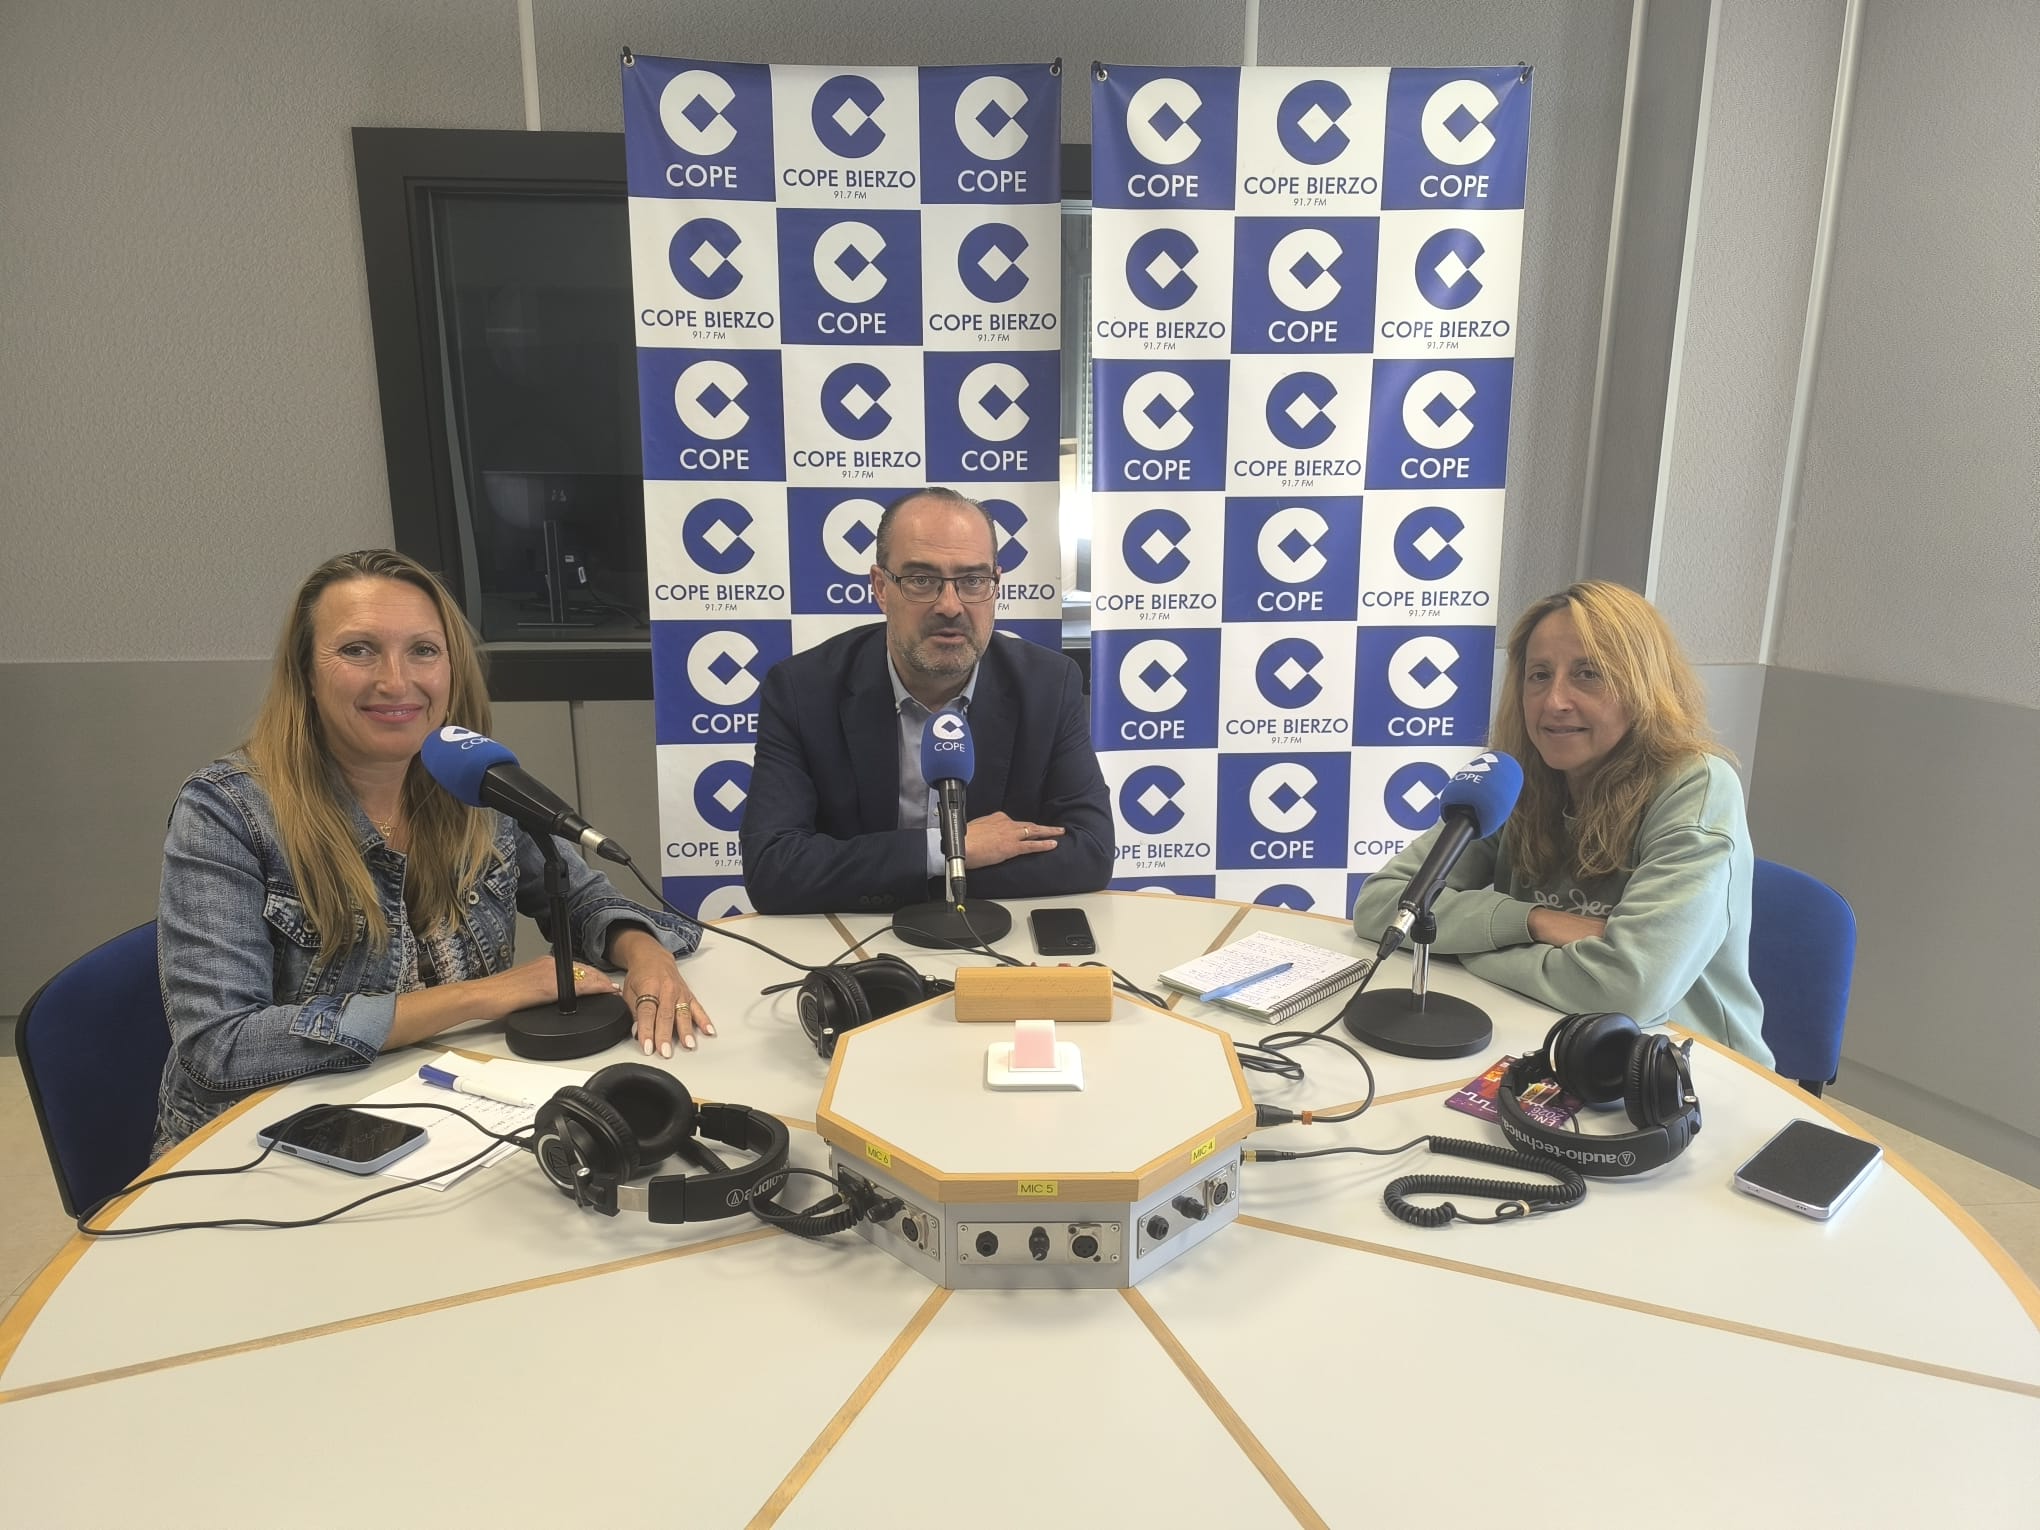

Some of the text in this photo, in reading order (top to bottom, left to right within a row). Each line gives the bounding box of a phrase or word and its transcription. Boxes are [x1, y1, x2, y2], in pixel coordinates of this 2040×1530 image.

[667, 164, 737, 188] COPE
[783, 169, 915, 188] COPE BIERZO
[958, 170, 1026, 192] COPE
[1128, 175, 1198, 197] COPE
[1244, 177, 1377, 194] COPE BIERZO
[1421, 175, 1489, 197] COPE
[834, 191, 866, 199] 91.7 FM
[1294, 198, 1326, 206] 91.7 FM
[642, 309, 774, 328] COPE BIERZO
[818, 312, 886, 333] COPE
[930, 313, 1056, 331] COPE BIERZO
[693, 331, 725, 340] 91.7 FM
[1097, 321, 1225, 338] COPE BIERZO
[1269, 321, 1337, 342] COPE
[1382, 320, 1510, 338] COPE BIERZO
[978, 334, 1009, 342] 91.7 FM
[1144, 342, 1175, 350] 91.7 FM
[1427, 342, 1444, 350] 91.7
[680, 449, 749, 469] COPE
[794, 451, 921, 467] COPE BIERZO
[962, 451, 1027, 471] COPE
[843, 471, 873, 479] 91.7 FM
[1124, 460, 1190, 480] COPE
[1234, 460, 1361, 476] COPE BIERZO
[1401, 458, 1469, 478] COPE
[1282, 480, 1299, 488] 91.7
[656, 585, 784, 600] COPE BIERZO
[826, 583, 874, 604] CO
[1363, 591, 1489, 607] COPE BIERZO
[705, 604, 722, 612] 91.7
[998, 603, 1009, 611] FM
[1096, 594, 1216, 610] COPE BIERZO
[1258, 592, 1323, 611] COPE
[1140, 613, 1156, 621] 91.7
[692, 714, 758, 733] COPE
[1121, 720, 1184, 740] COPE
[1226, 719, 1348, 736] COPE BIERZO
[1388, 717, 1453, 736] COPE
[934, 742, 965, 752] COPE
[1452, 773, 1484, 784] OPE
[667, 842, 718, 857] COPE
[1113, 843, 1210, 860] PE BIERZO
[1251, 841, 1313, 859] COPE
[1354, 840, 1404, 856] COPE
[1193, 1141, 1214, 1160] MIC 4
[1501, 1119, 1616, 1165] audio-technica
[867, 1145, 889, 1164] MIC 6
[1020, 1184, 1054, 1193] MIC 5
